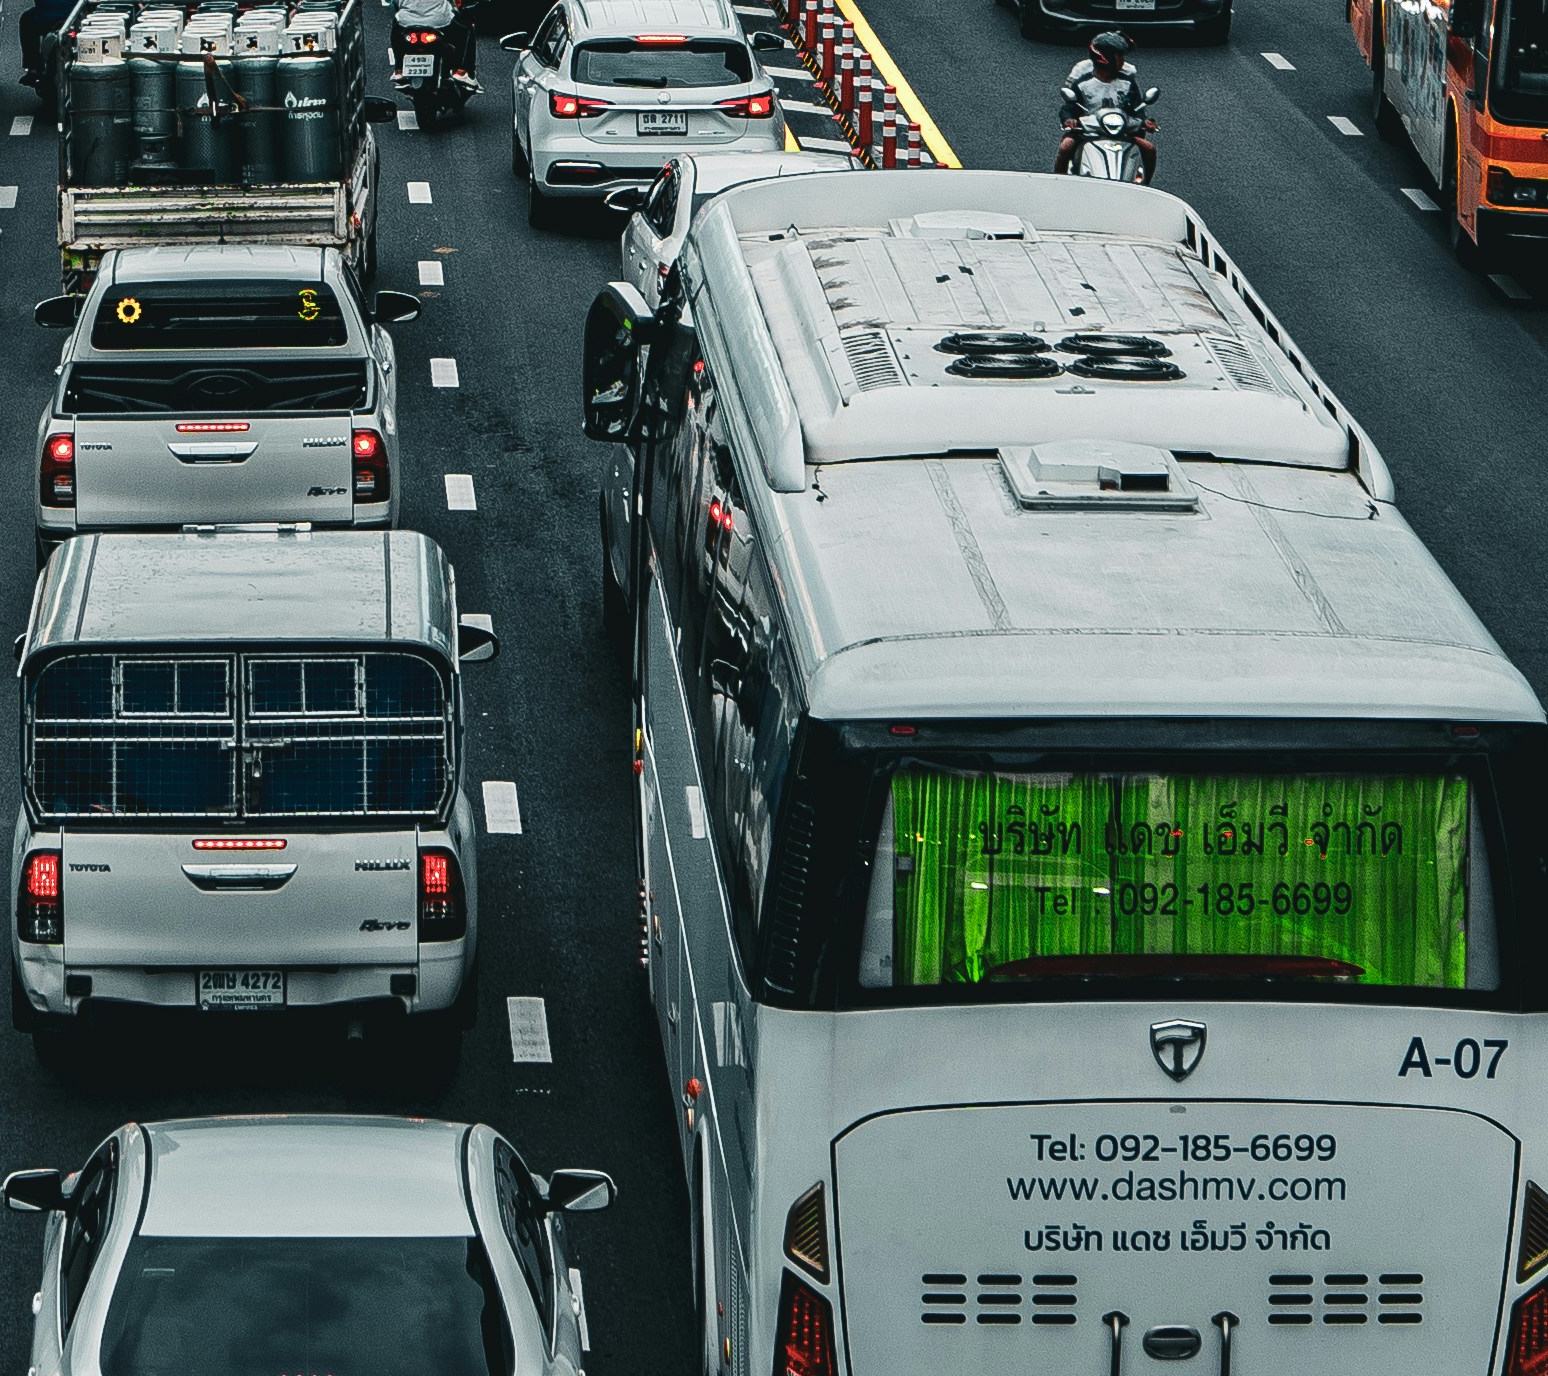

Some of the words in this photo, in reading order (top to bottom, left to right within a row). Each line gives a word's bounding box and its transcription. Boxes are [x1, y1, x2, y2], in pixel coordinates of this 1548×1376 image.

[661, 113, 684, 123] 2711
[977, 802, 1081, 860] บริษัท
[1200, 802, 1290, 858] เอ็มวี
[1309, 803, 1404, 858] จำกัด
[69, 863, 111, 873] TOYOTA
[355, 858, 412, 871] HILUX
[1117, 881, 1354, 919] 092-185-6699
[241, 971, 282, 989] 4272
[1397, 1038, 1509, 1079] A-07
[1031, 1133, 1086, 1163] Tel:
[1094, 1133, 1337, 1164] 092-185-6699
[1007, 1169, 1346, 1201] www.dashmv.com
[1023, 1218, 1103, 1252] บริษัท
[1112, 1224, 1170, 1250] แดช
[1179, 1218, 1247, 1250] เอ็มวี
[1254, 1220, 1332, 1252] จำกัด
